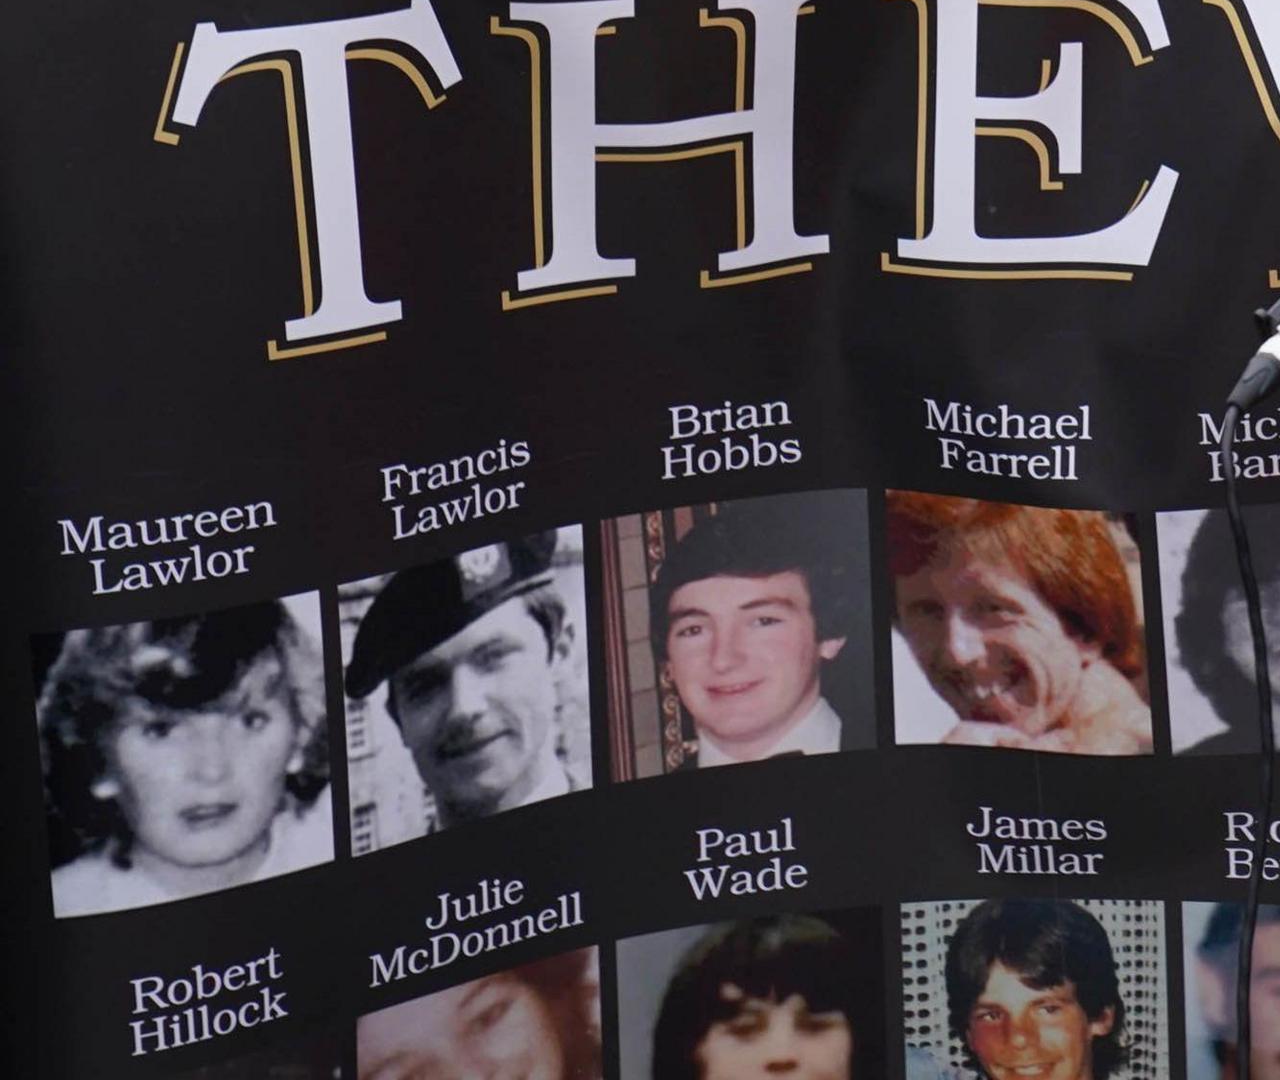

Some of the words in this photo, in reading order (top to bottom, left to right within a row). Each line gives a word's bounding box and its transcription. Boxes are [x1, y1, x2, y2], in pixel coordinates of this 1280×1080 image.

[668, 400, 793, 440] Brian
[923, 398, 1093, 441] Michael
[380, 438, 531, 503] Francis
[660, 433, 802, 480] Hobbs
[938, 438, 1079, 482] Farrell
[57, 499, 278, 557] Maureen
[391, 477, 526, 541] Lawlor
[90, 540, 256, 595] Lawlor
[695, 817, 796, 862] Paul
[966, 807, 1108, 842] James
[683, 857, 808, 901] Wade
[976, 843, 1104, 876] Millar
[425, 875, 525, 930] Julie
[368, 893, 585, 988] McDonnell
[129, 946, 285, 1016] Robert
[129, 985, 289, 1057] Hillock
